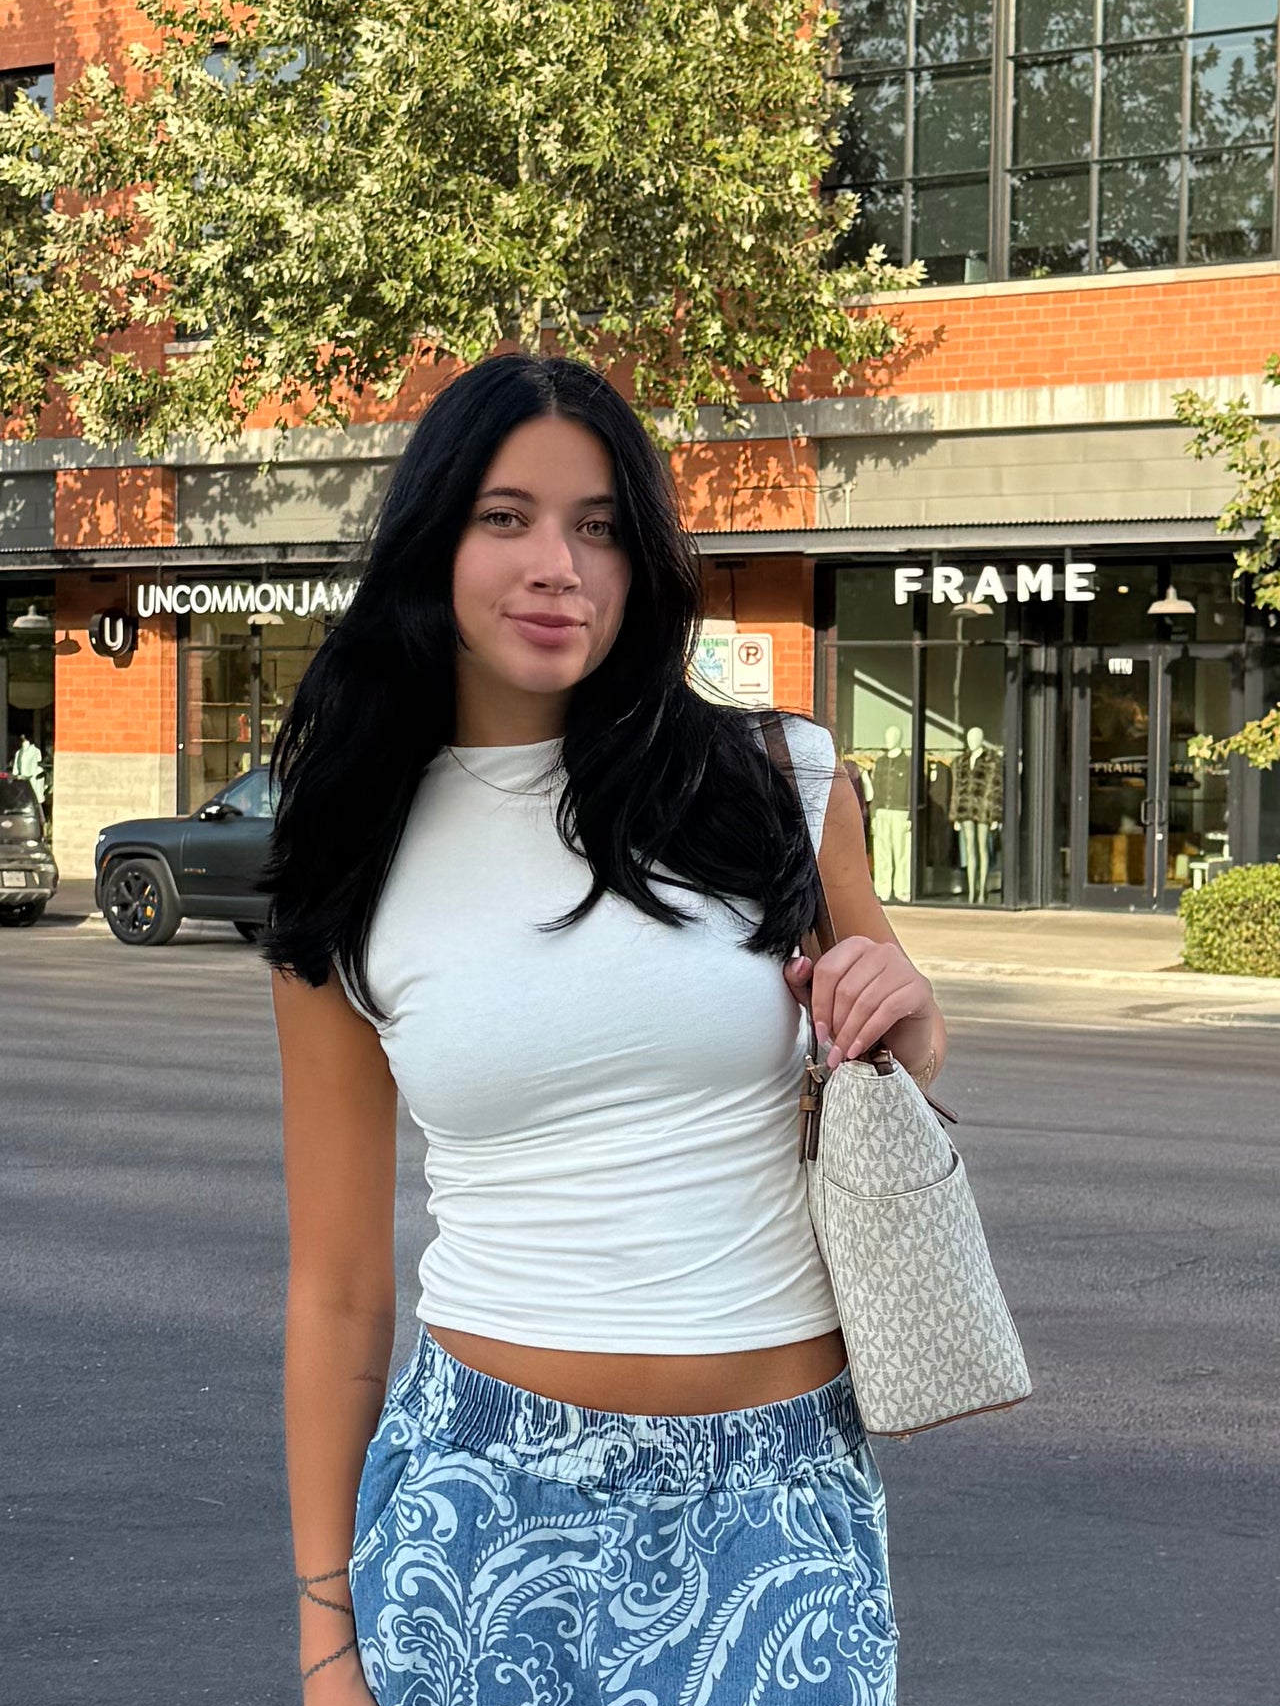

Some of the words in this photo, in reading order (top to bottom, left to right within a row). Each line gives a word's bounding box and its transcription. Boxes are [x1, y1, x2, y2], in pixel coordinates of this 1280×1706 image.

[137, 583, 294, 617] UNCOMMON
[295, 581, 360, 617] JAM
[894, 563, 1096, 605] FRAME
